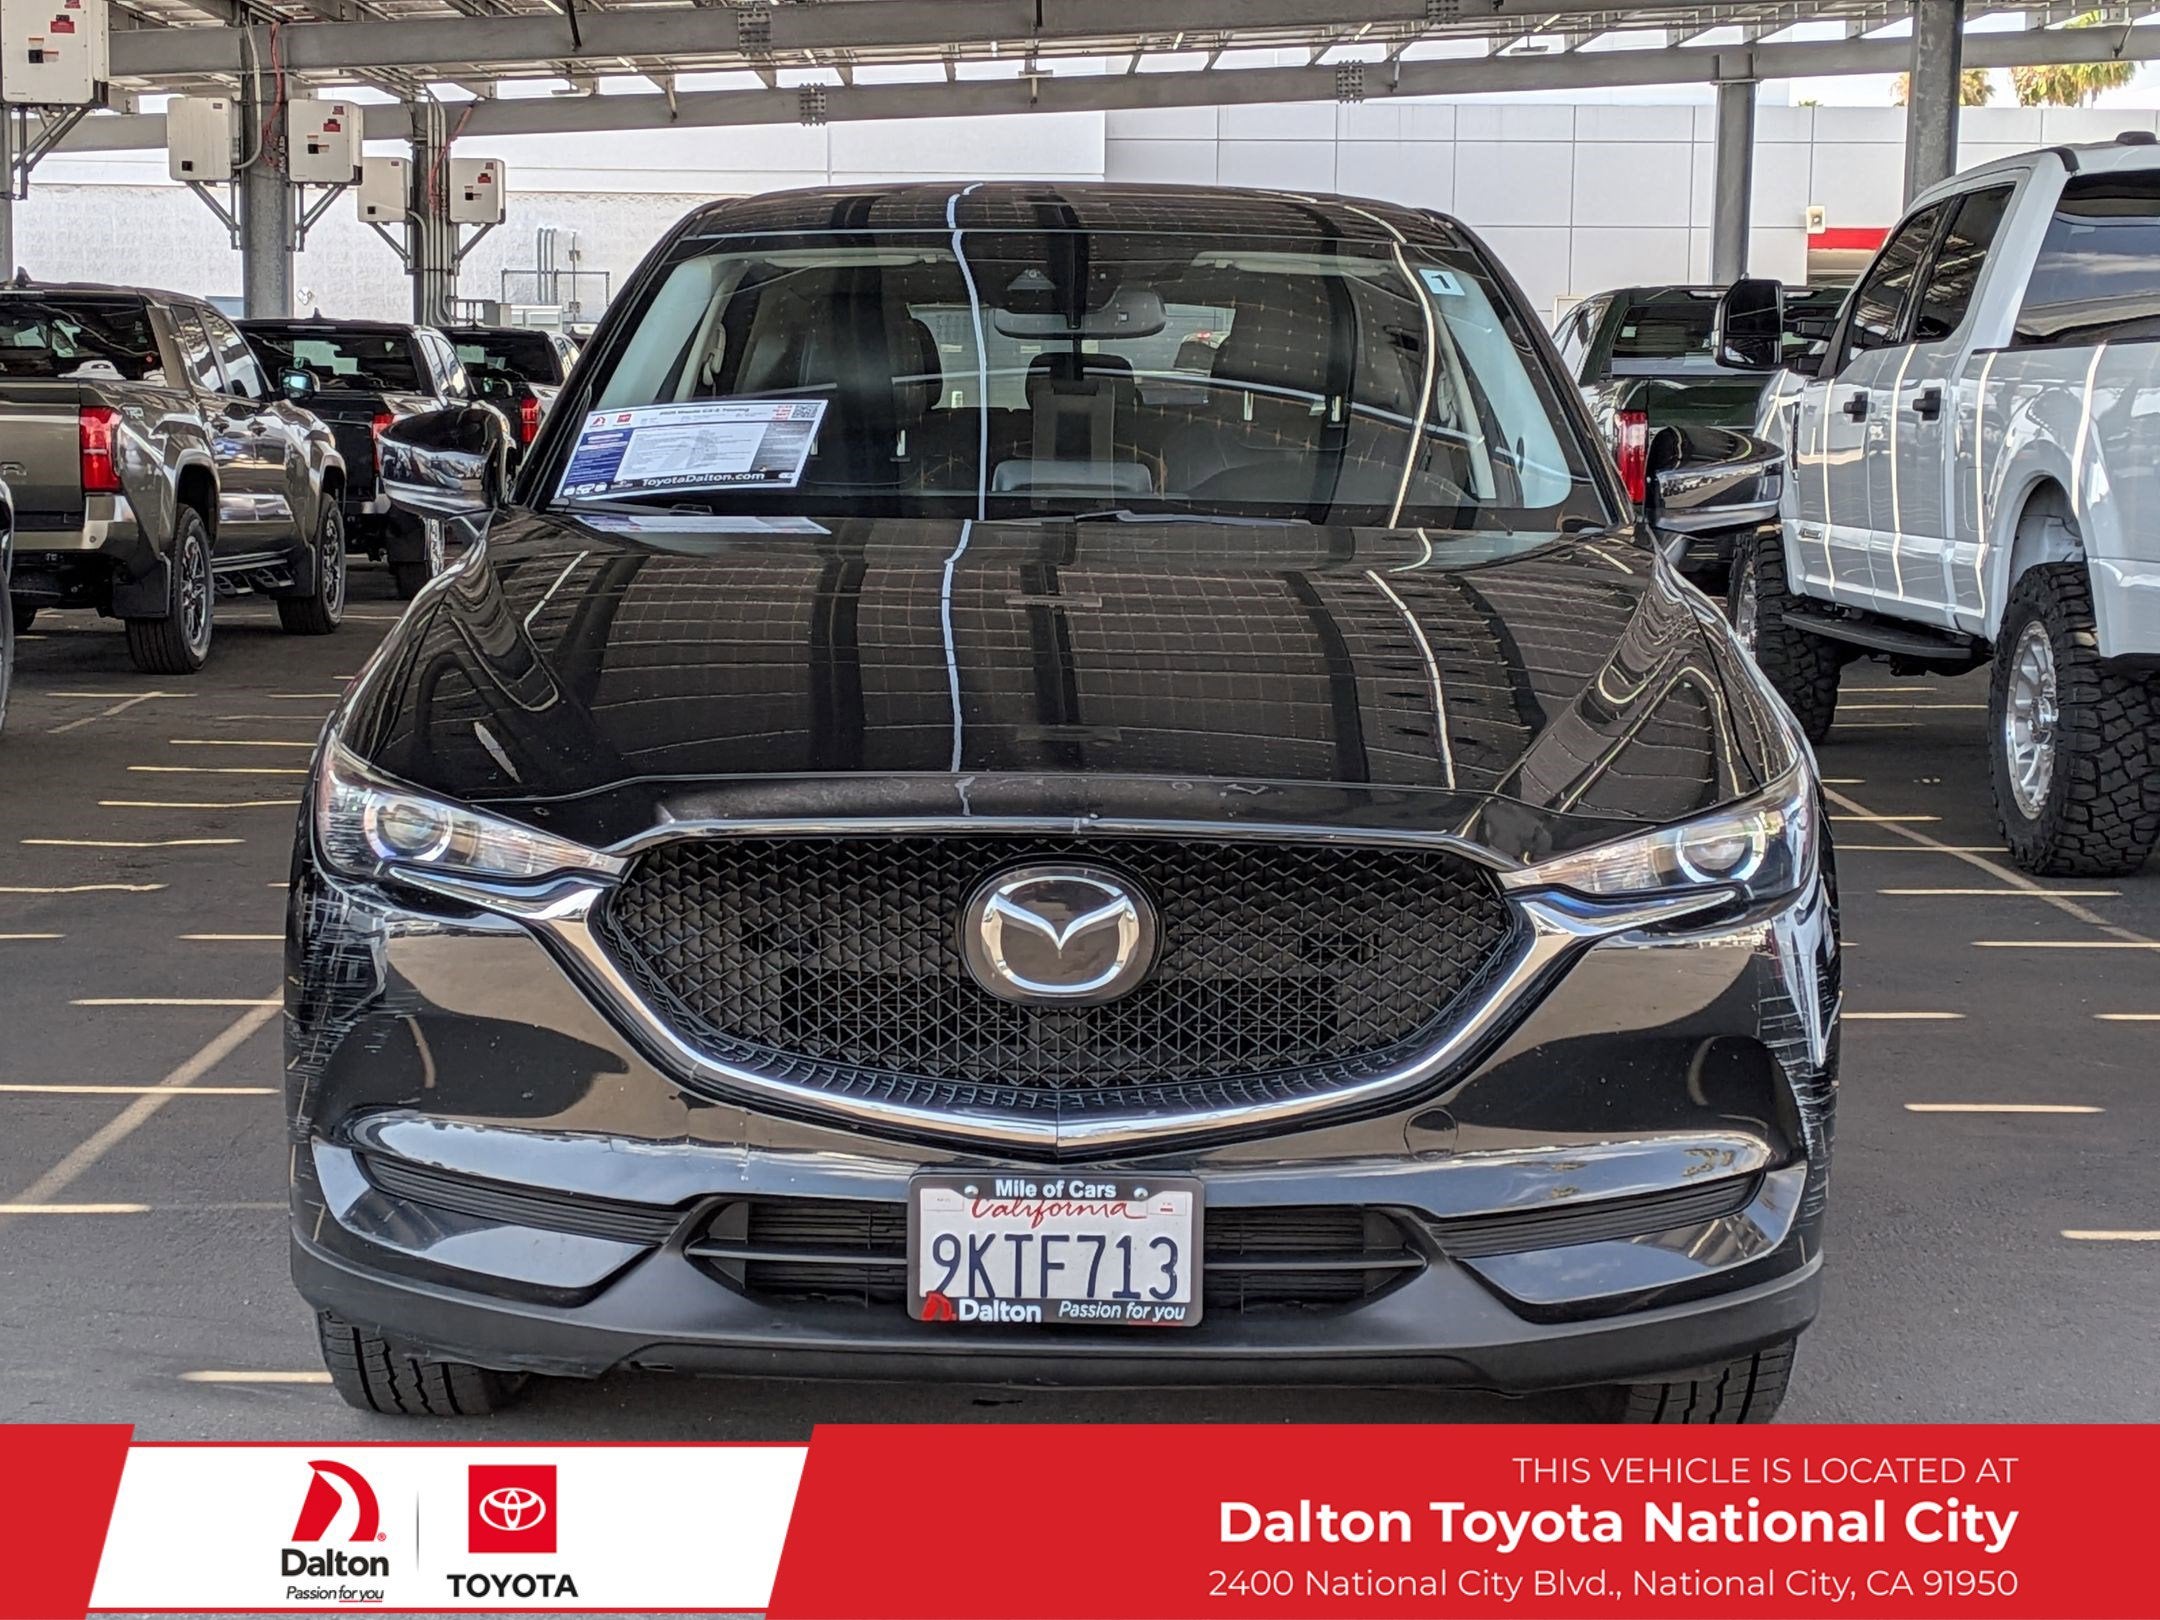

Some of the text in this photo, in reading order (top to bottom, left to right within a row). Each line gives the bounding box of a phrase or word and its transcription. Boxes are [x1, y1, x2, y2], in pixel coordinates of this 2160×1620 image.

[642, 471, 766, 487] ToyotaDalton.com
[995, 1179, 1117, 1199] Mile of Cars
[971, 1196, 1148, 1229] California
[932, 1233, 1178, 1300] 9KTF713
[958, 1299, 1041, 1323] Dalton
[1058, 1300, 1186, 1323] Passion for you
